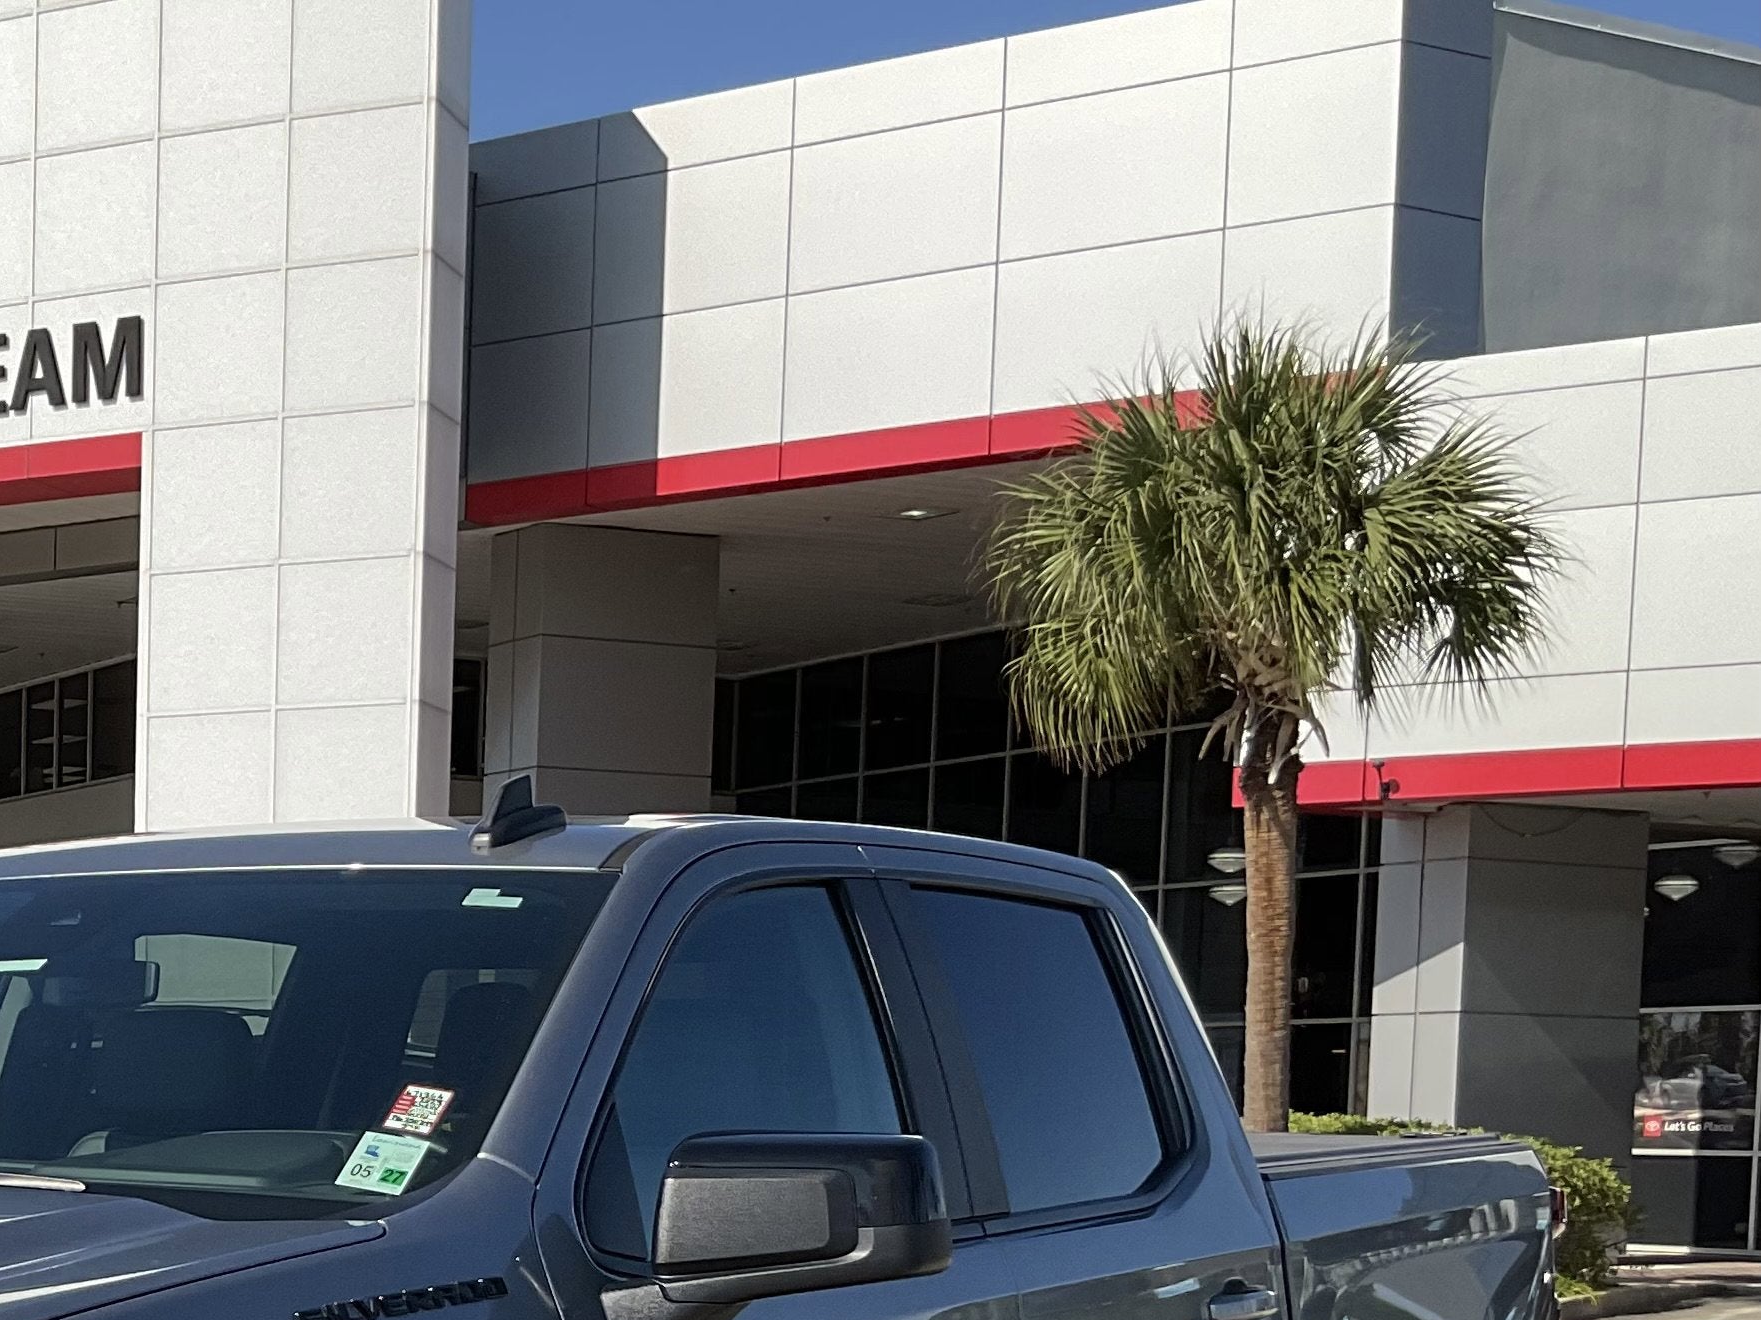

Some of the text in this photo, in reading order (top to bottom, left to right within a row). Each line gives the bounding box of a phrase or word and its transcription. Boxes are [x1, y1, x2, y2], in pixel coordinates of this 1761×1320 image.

[1664, 1121, 1686, 1132] Let's
[1687, 1121, 1702, 1132] Go
[350, 1163, 375, 1178] 05
[379, 1168, 409, 1184] 27
